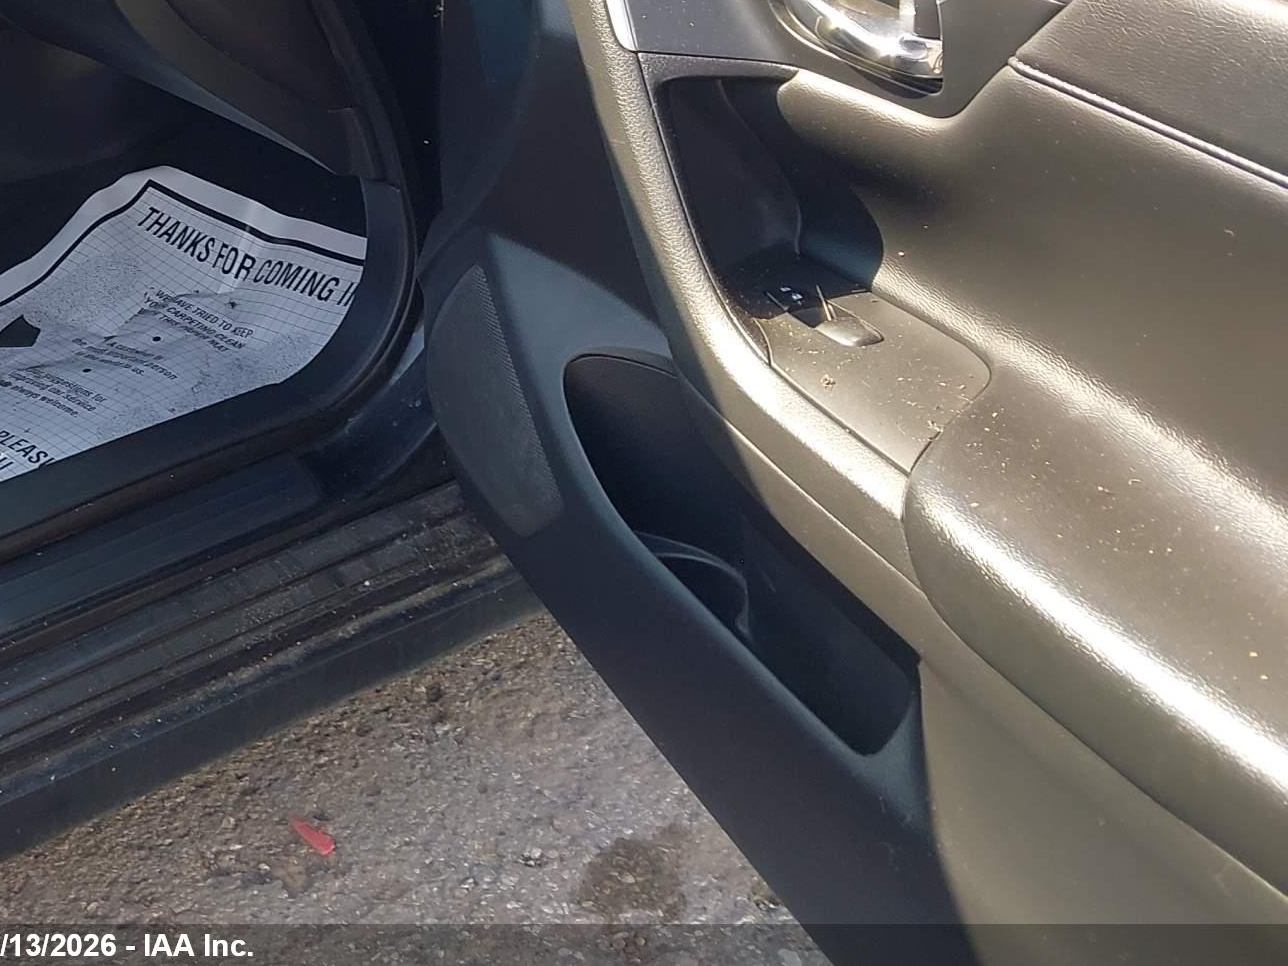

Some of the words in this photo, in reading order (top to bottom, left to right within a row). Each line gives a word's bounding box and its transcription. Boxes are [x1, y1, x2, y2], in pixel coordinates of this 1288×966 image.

[137, 207, 215, 263] THANKS
[212, 242, 257, 283] FOR
[253, 259, 340, 303] COMING
[155, 290, 172, 301] WE
[192, 307, 220, 324] TRIED
[218, 319, 233, 331] TO
[167, 307, 217, 335] CARPETING
[215, 334, 246, 349] CLEAN
[208, 339, 231, 352] MAT
[143, 361, 178, 380] person
[62, 394, 96, 412] service
[92, 393, 108, 403] for
